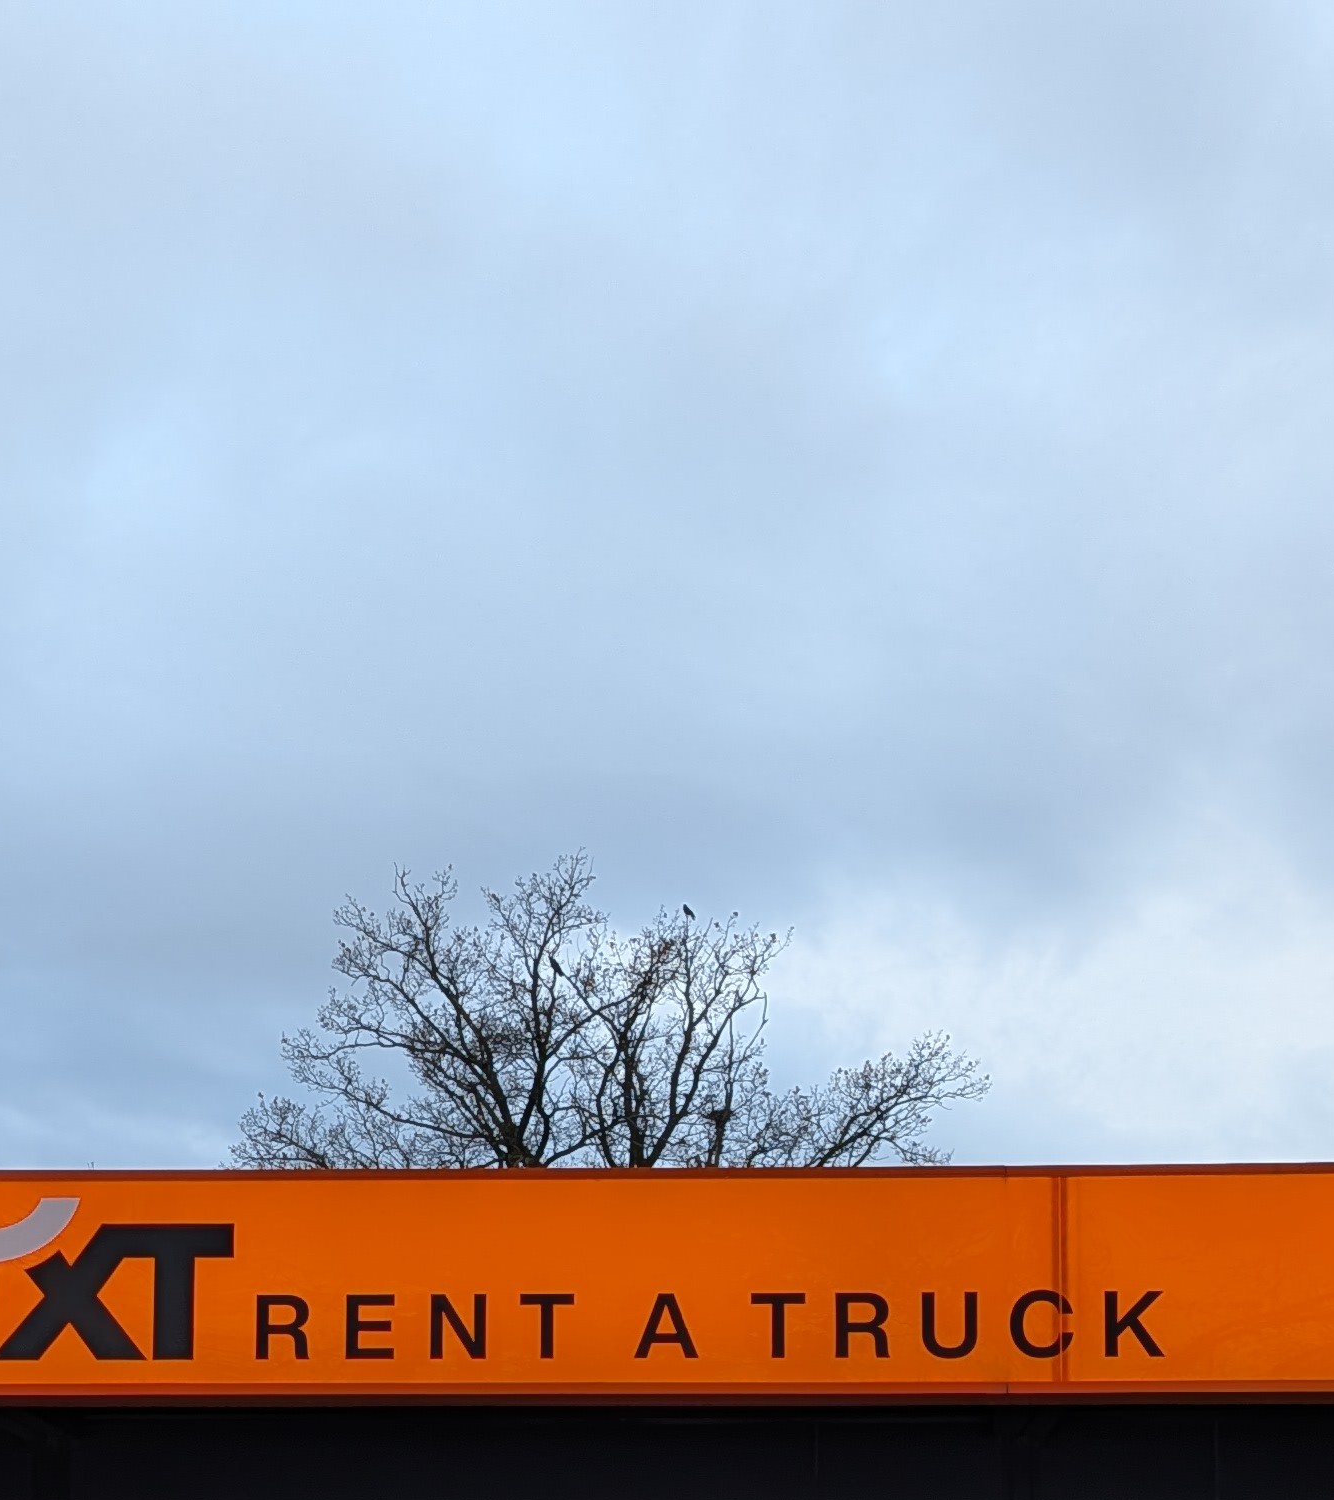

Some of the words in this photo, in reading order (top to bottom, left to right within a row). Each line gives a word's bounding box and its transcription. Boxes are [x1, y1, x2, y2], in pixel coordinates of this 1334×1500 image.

[255, 1293, 575, 1360] RENT
[633, 1293, 700, 1359] A
[750, 1289, 1166, 1360] TRUCK
